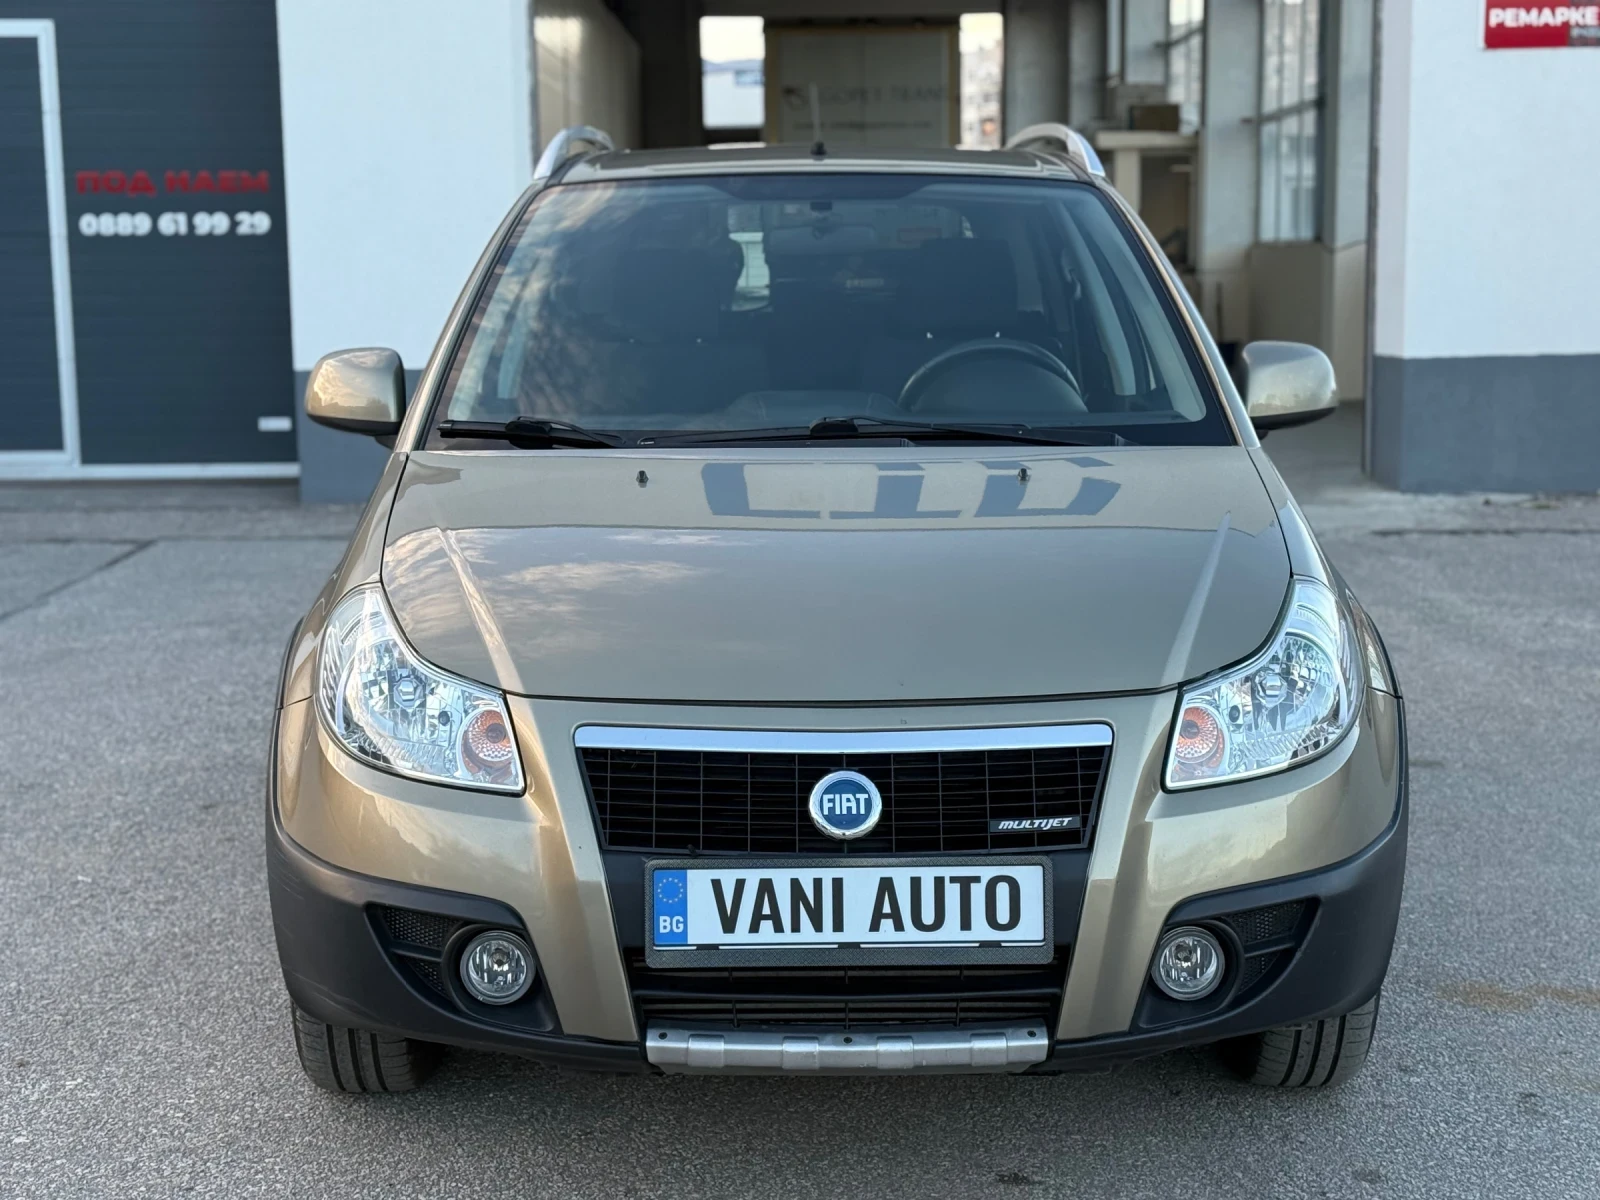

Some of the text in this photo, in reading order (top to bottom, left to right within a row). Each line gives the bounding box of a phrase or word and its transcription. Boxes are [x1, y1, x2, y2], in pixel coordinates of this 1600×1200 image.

[76, 170, 270, 197] ПОД НАЕМ
[78, 211, 272, 237] 0889 61 99 29
[822, 793, 869, 815] FIAT
[998, 817, 1073, 830] MULTIJET
[710, 875, 1021, 934] VANI AUTO
[659, 915, 685, 933] BG
